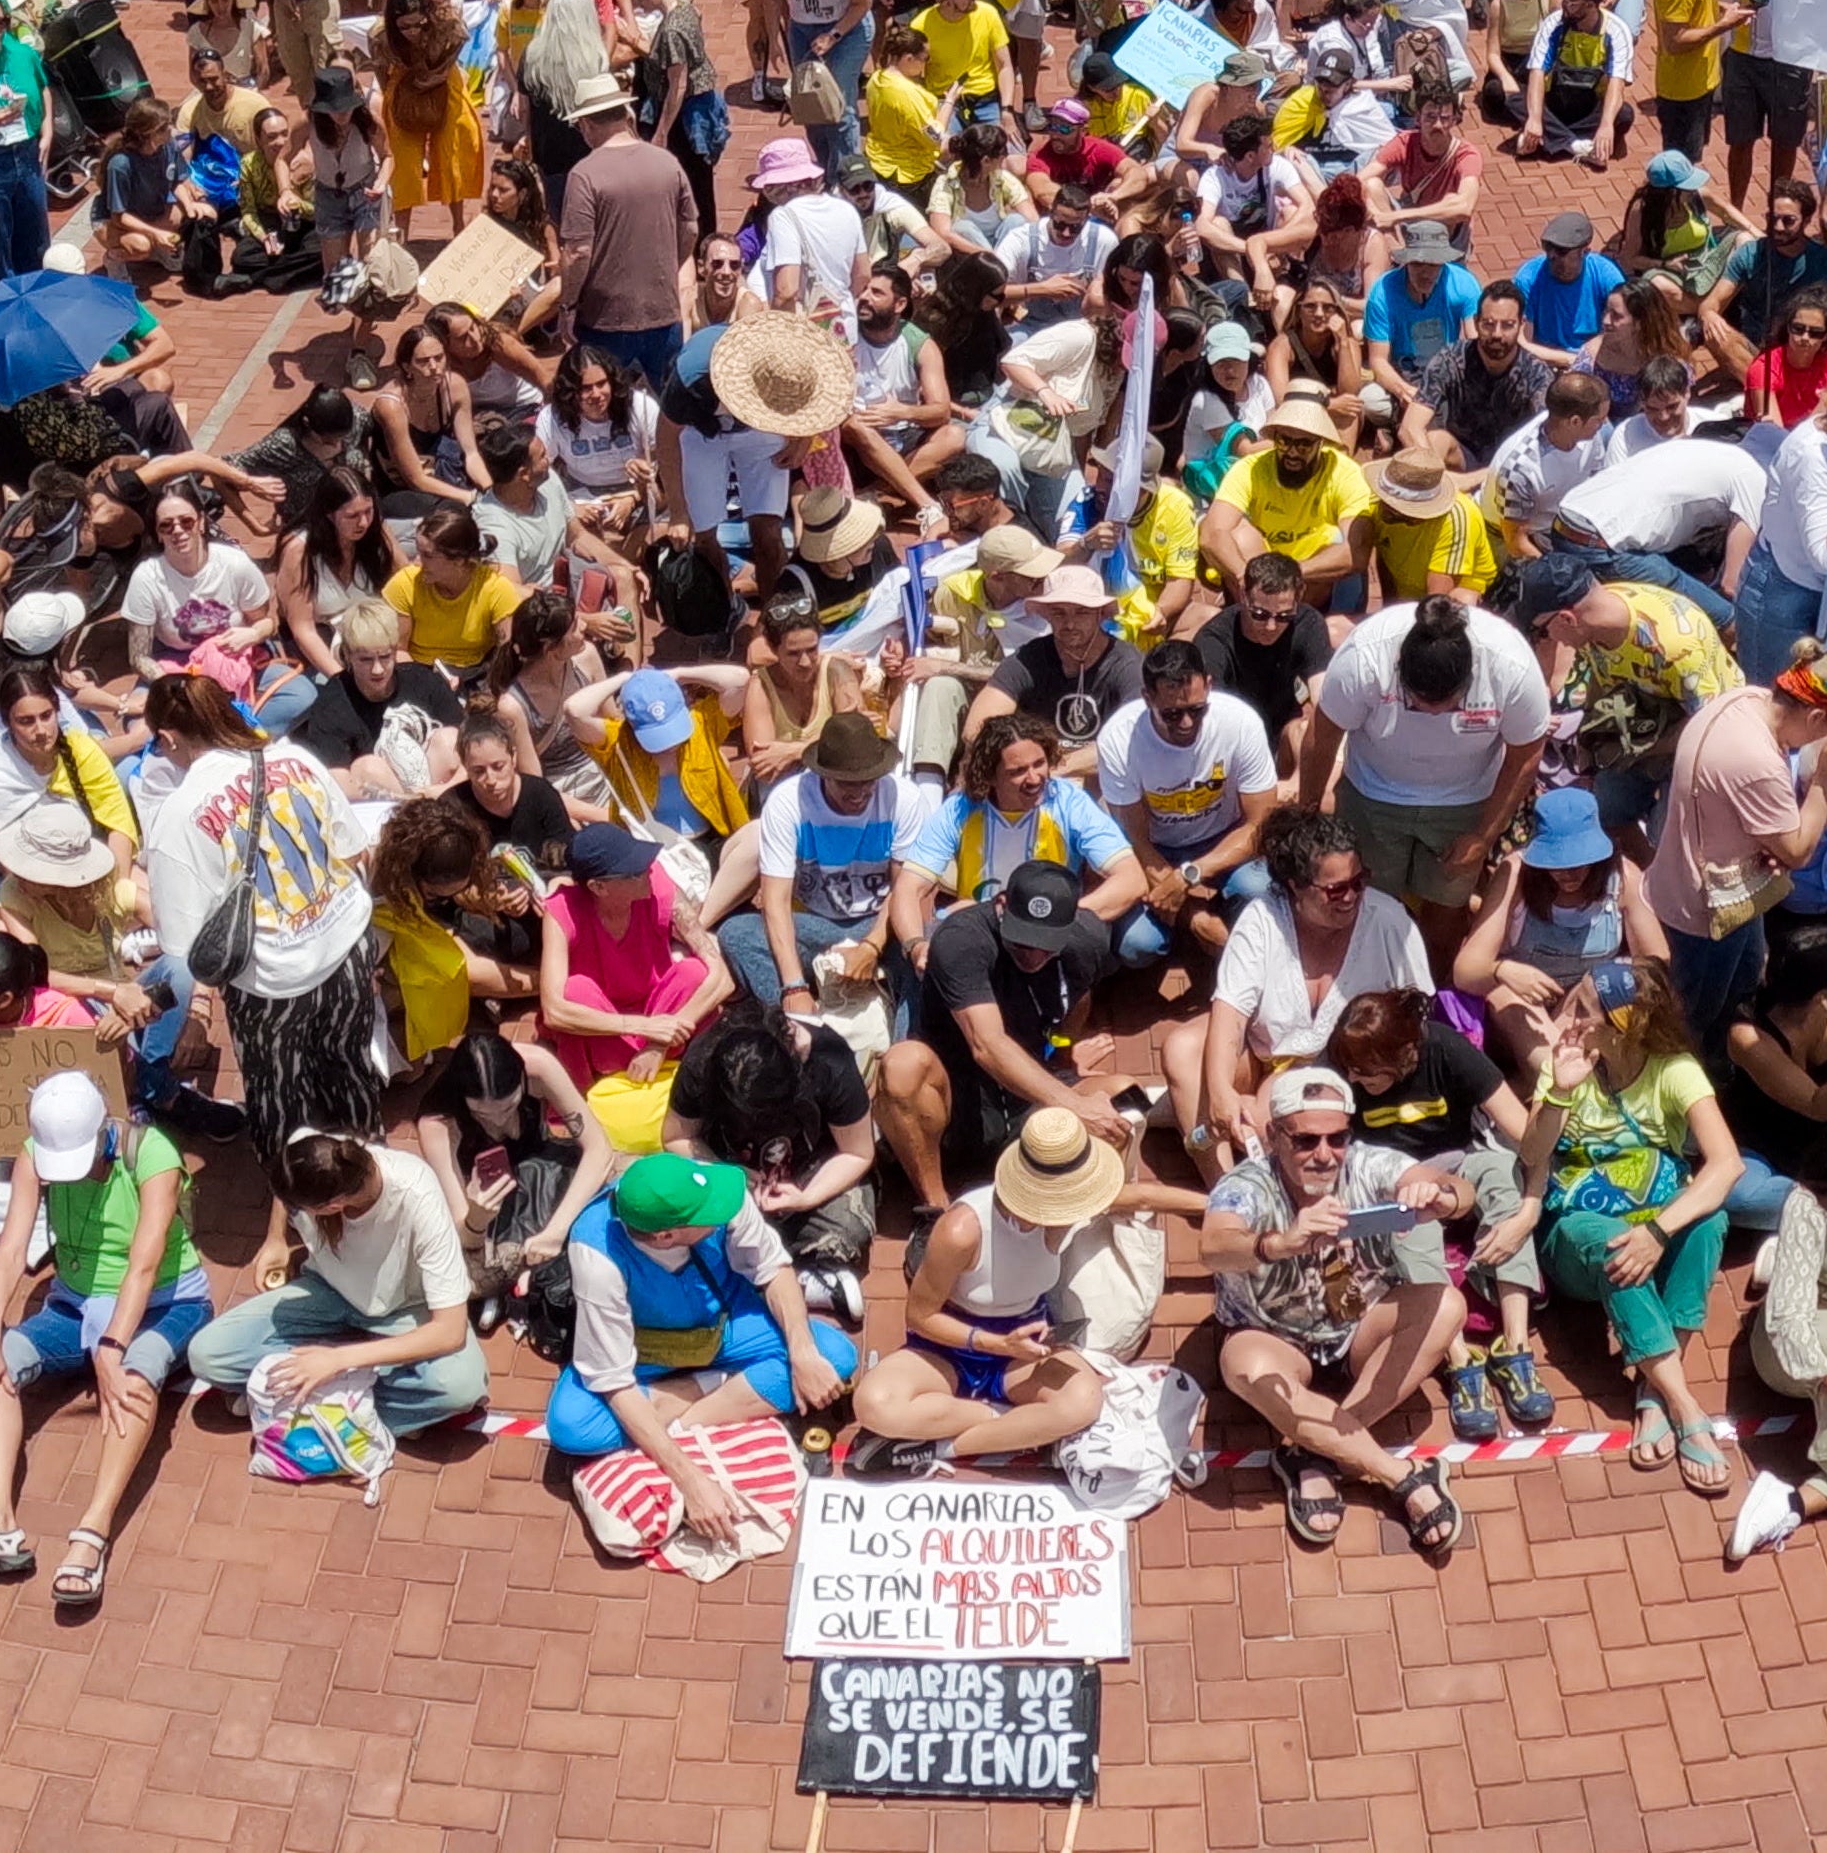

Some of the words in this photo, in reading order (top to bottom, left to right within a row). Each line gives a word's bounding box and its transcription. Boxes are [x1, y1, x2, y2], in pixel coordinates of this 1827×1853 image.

[31, 1038, 78, 1069] NO
[820, 1492, 865, 1524] EN
[885, 1492, 1055, 1524] CANARIAS
[850, 1528, 912, 1559] LOS
[919, 1519, 1115, 1566] ALQUILERES
[813, 1567, 922, 1602] ESTÁN
[1011, 1564, 1103, 1599] ALTOS
[818, 1609, 897, 1641] QUE
[904, 1607, 944, 1640] EL
[944, 1601, 1069, 1649] TEIDE
[820, 1662, 1006, 1702] CANARIAS
[1017, 1667, 1075, 1701] NO
[827, 1701, 872, 1733] SE
[884, 1701, 1017, 1735] VENDE,
[1020, 1700, 1075, 1733] SE
[853, 1732, 1088, 1789] DEFIENDE
